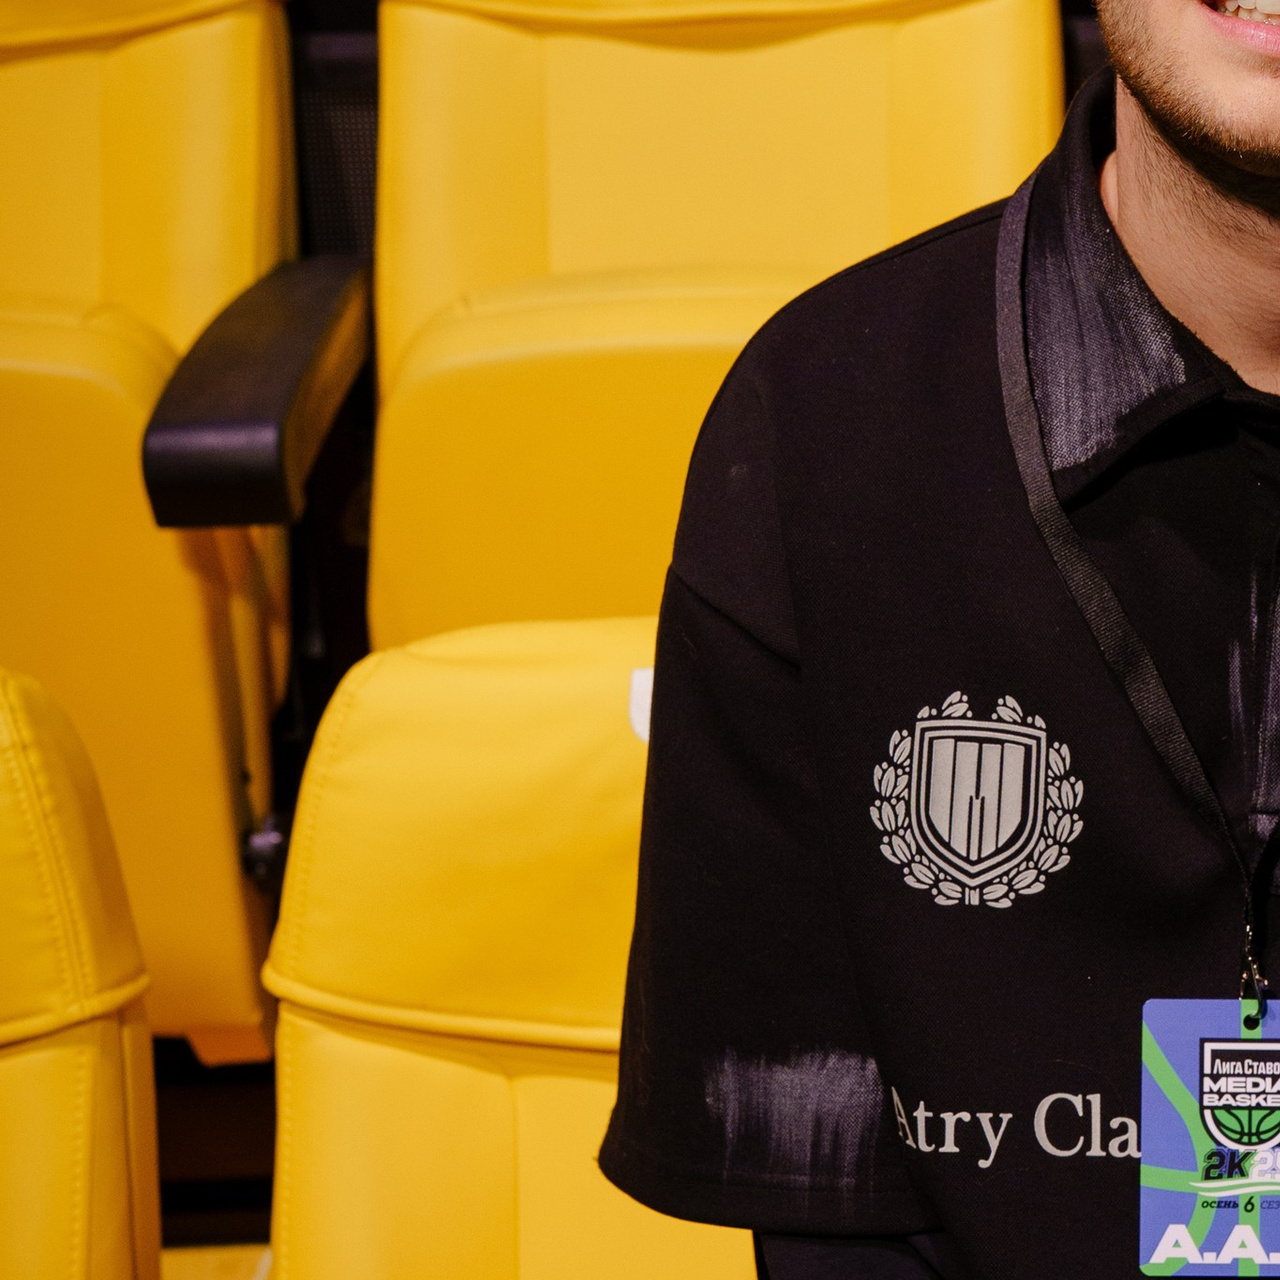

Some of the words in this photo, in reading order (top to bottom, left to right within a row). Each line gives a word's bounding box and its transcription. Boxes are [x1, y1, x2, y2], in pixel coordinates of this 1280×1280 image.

[1033, 1092, 1142, 1158] Cla
[1201, 1199, 1240, 1211] ОСЕНЬ
[1243, 1195, 1256, 1214] 6
